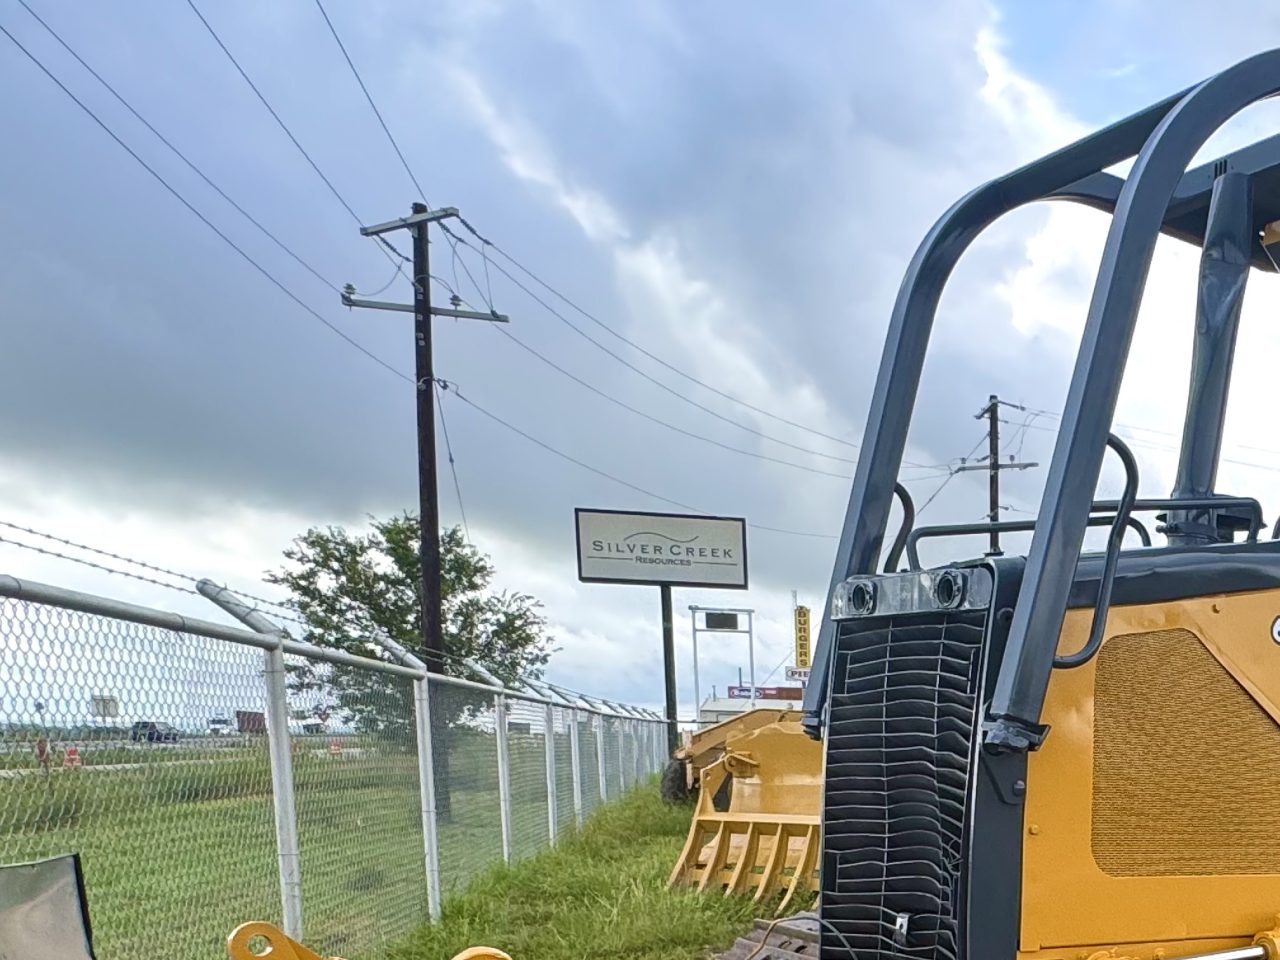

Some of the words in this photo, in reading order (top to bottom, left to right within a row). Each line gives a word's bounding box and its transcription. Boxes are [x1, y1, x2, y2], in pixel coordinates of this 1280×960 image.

[593, 540, 663, 555] SILVER
[669, 545, 733, 559] CREEK
[635, 556, 691, 566] RESOURCES
